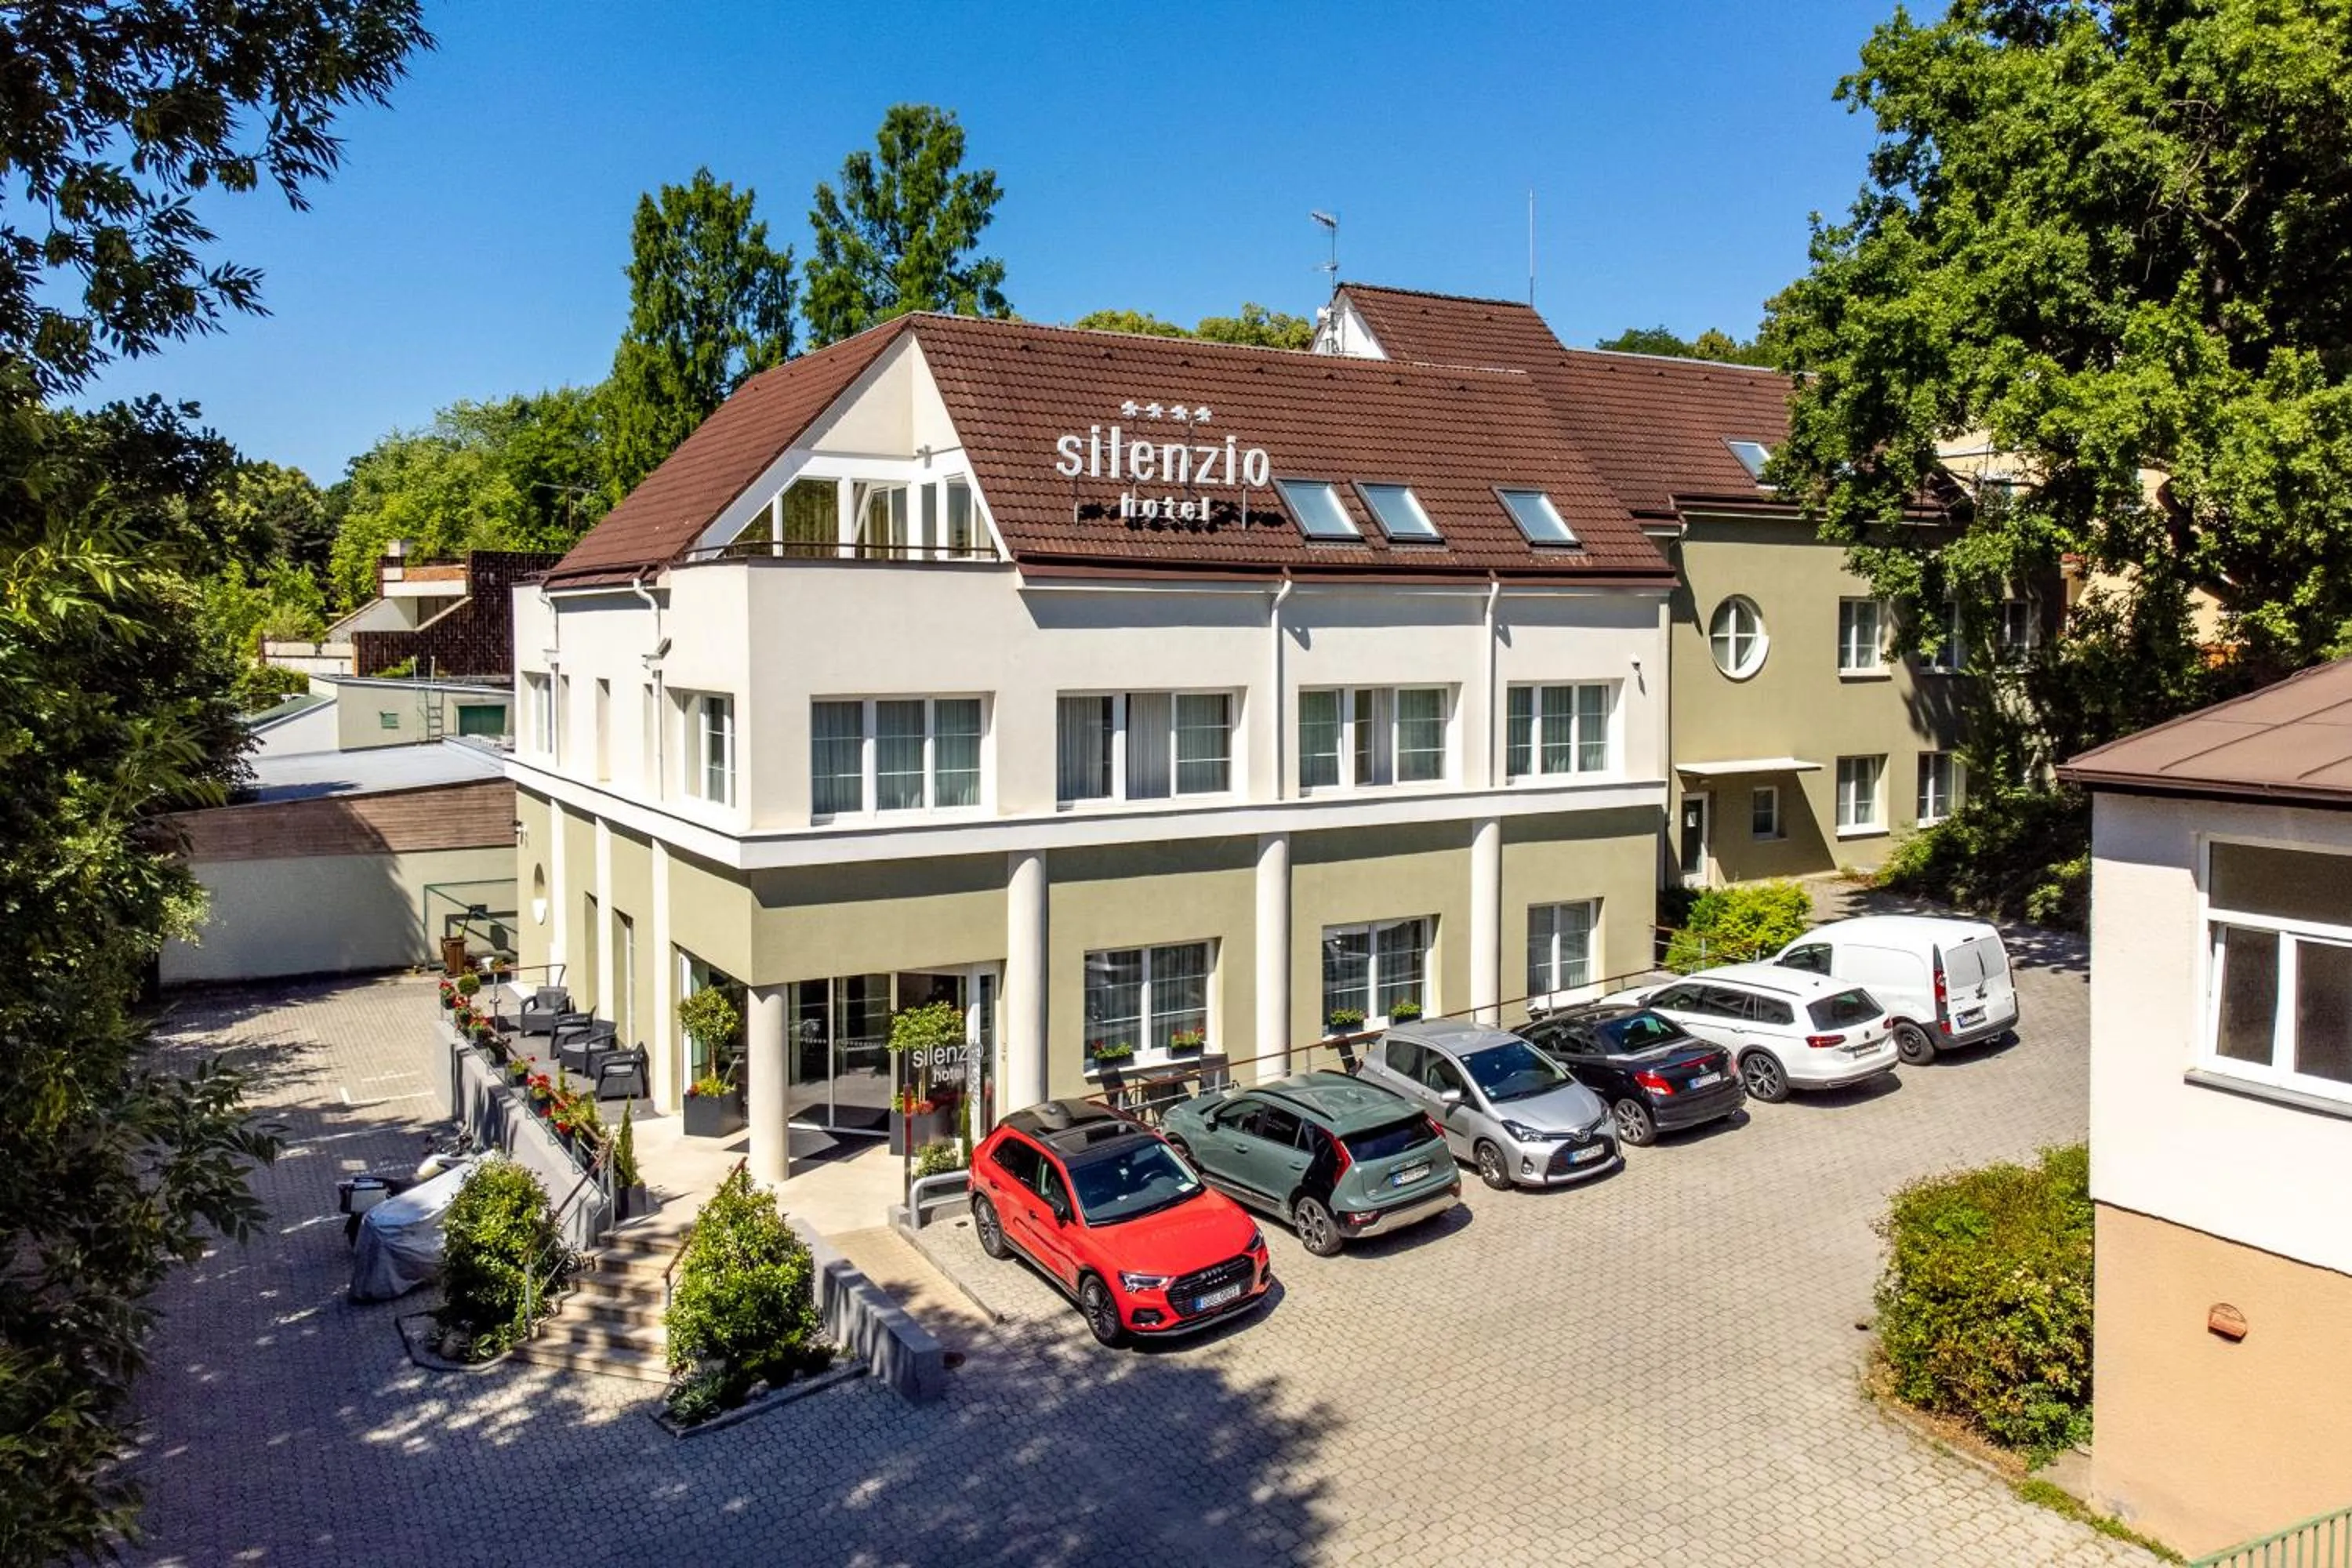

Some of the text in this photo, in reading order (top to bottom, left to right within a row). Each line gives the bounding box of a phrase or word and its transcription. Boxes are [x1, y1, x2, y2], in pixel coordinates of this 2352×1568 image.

[1057, 425, 1269, 487] silenzio
[1121, 492, 1210, 521] hotel
[913, 1043, 984, 1068] silenzo
[933, 1064, 965, 1082] hotel
